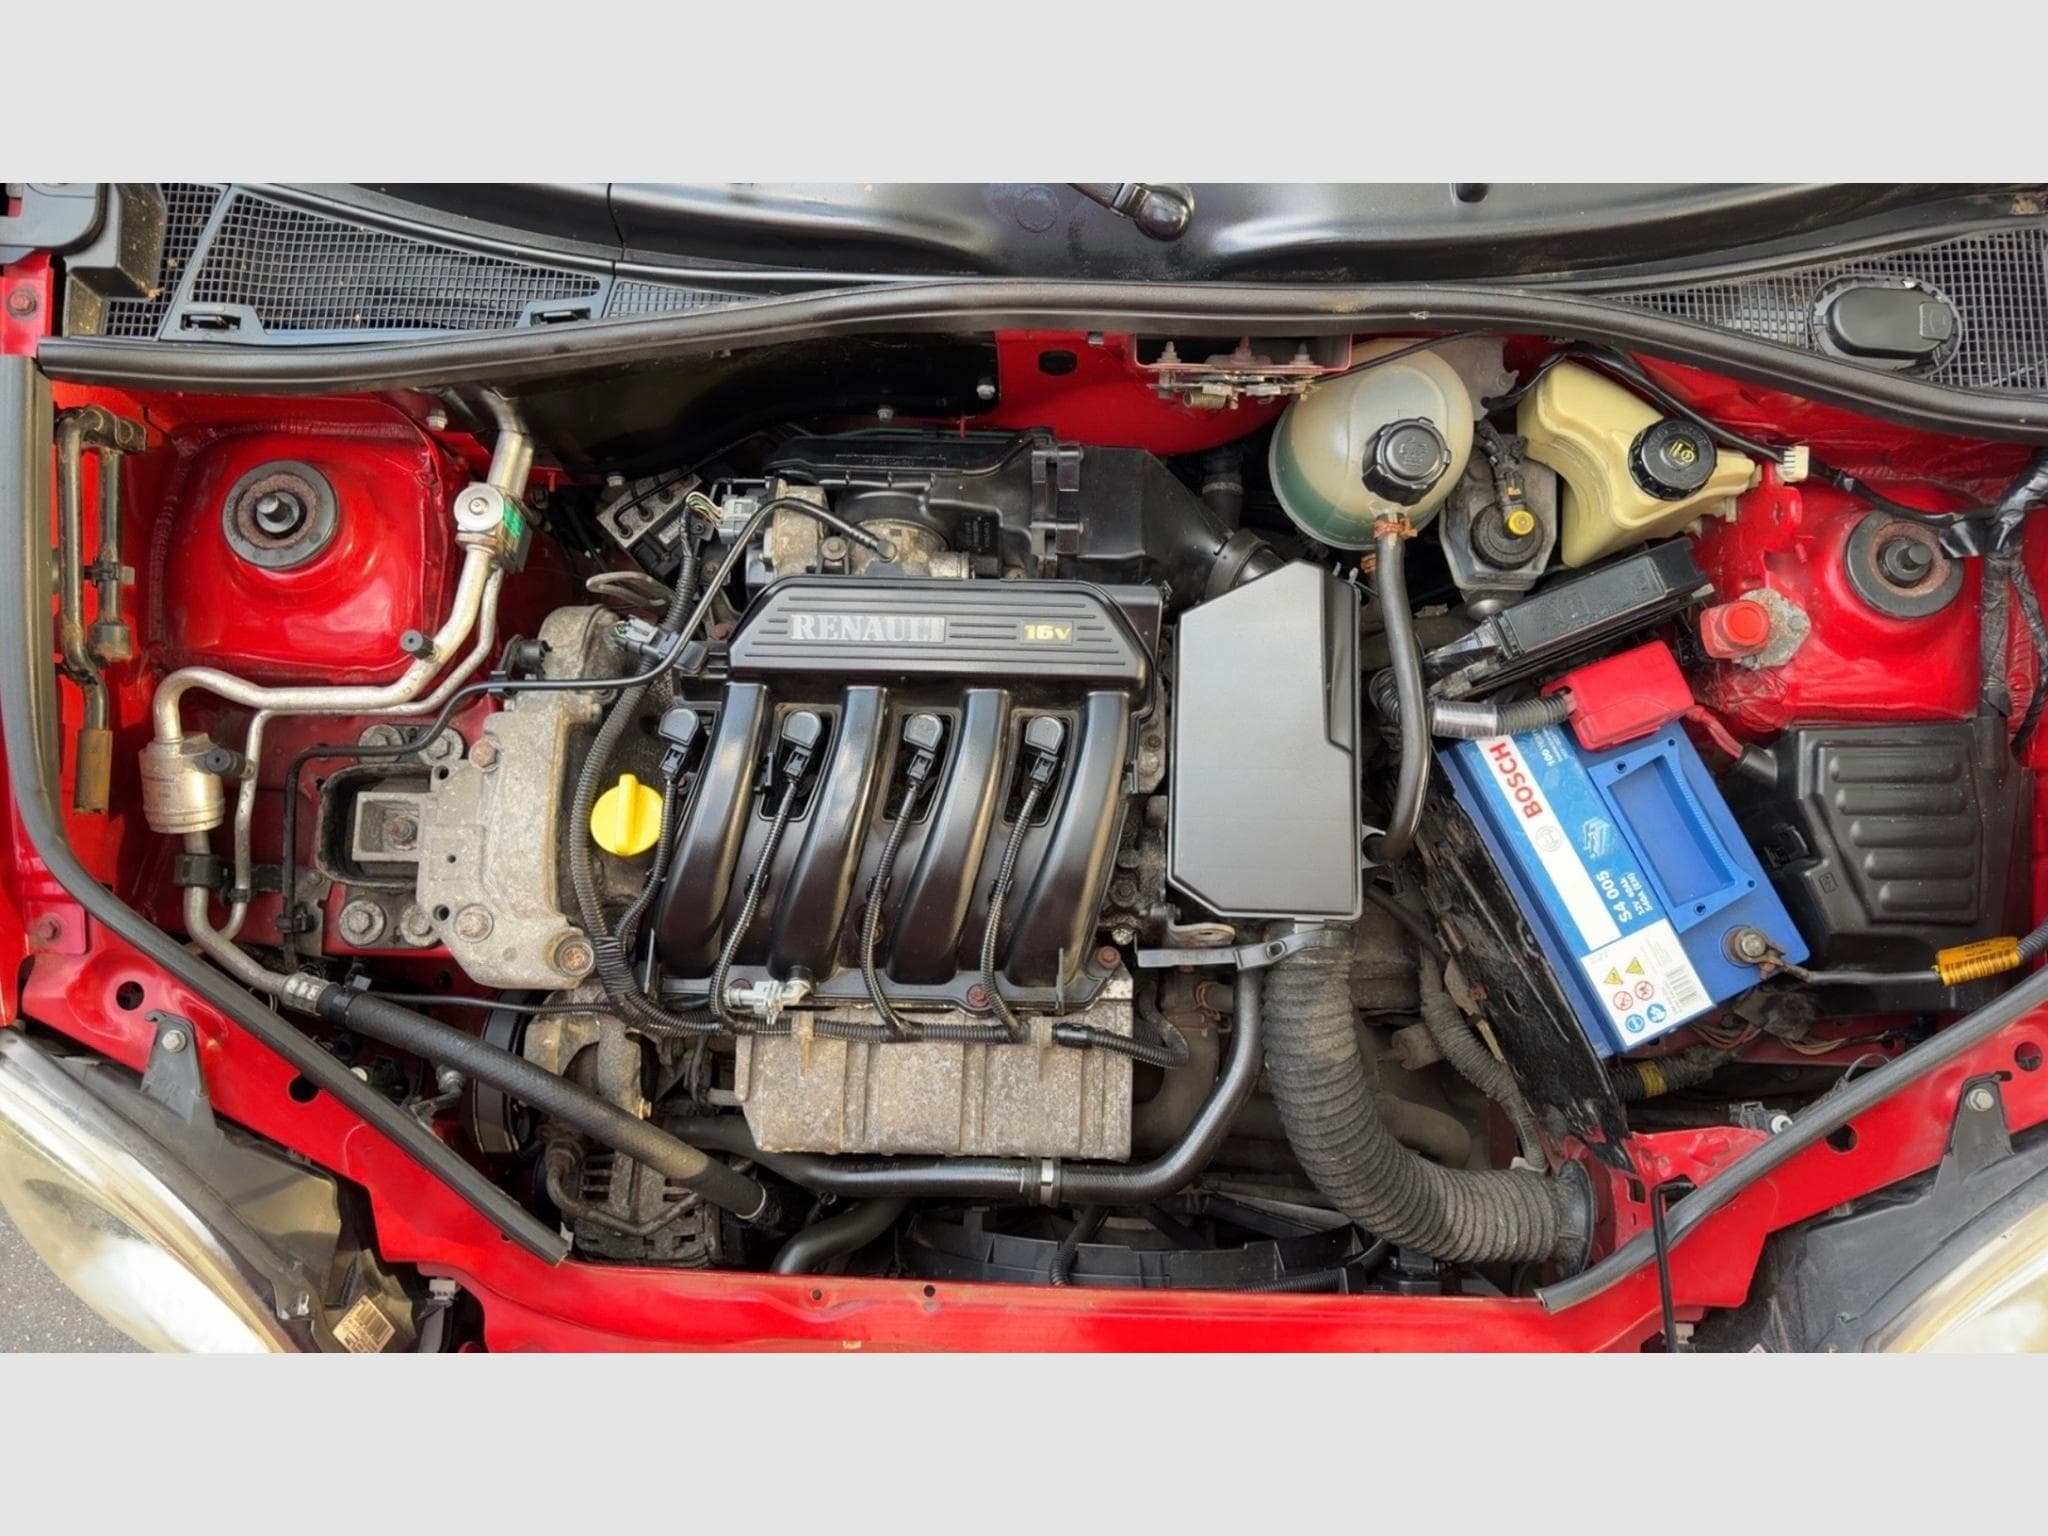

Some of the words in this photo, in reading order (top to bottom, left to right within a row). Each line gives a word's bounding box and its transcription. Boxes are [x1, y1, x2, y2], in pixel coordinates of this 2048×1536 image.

[790, 614, 945, 642] RENAULT
[1541, 748, 1556, 767] 100
[1489, 742, 1543, 818] BOSCH
[1595, 869, 1619, 900] 005
[1613, 901, 1633, 923] S4
